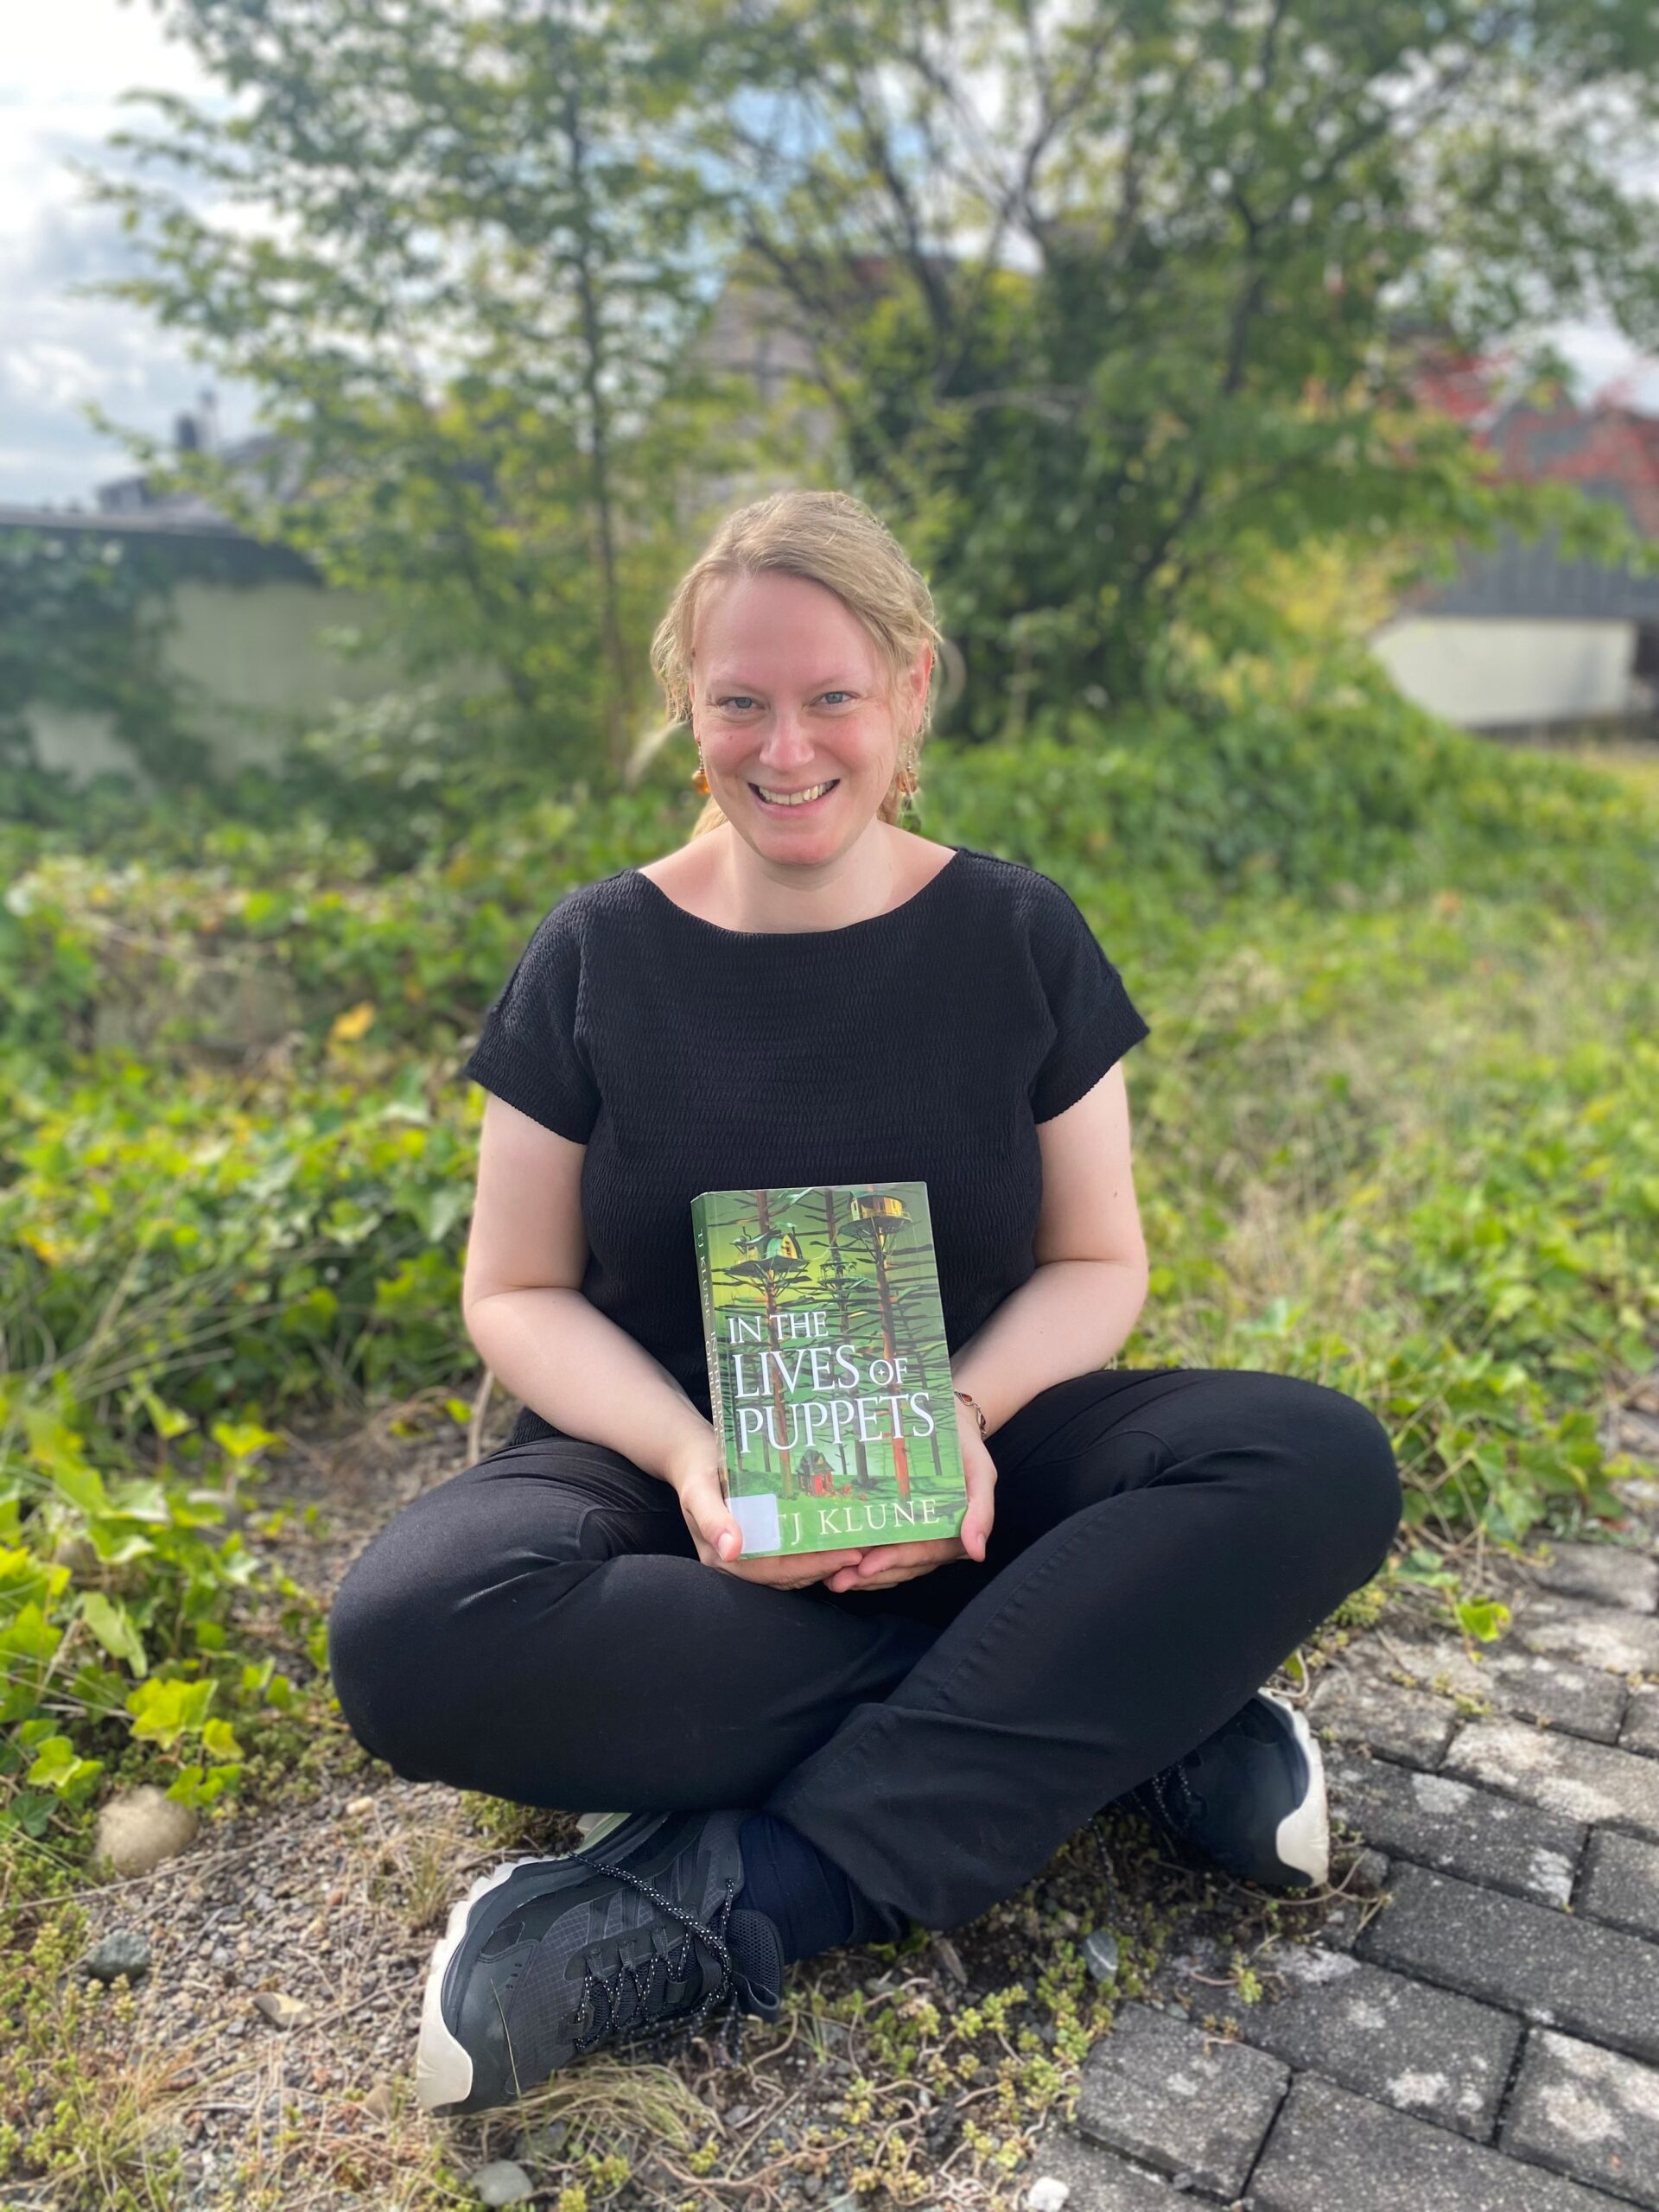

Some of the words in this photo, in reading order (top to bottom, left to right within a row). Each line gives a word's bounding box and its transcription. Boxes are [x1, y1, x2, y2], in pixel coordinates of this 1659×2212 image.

[728, 1316, 761, 1344] IN
[770, 1312, 829, 1339] THE
[733, 1344, 860, 1398] LIVES
[868, 1357, 908, 1385] OF
[735, 1392, 935, 1453] PUPPETS
[818, 1499, 940, 1535] KLUNE
